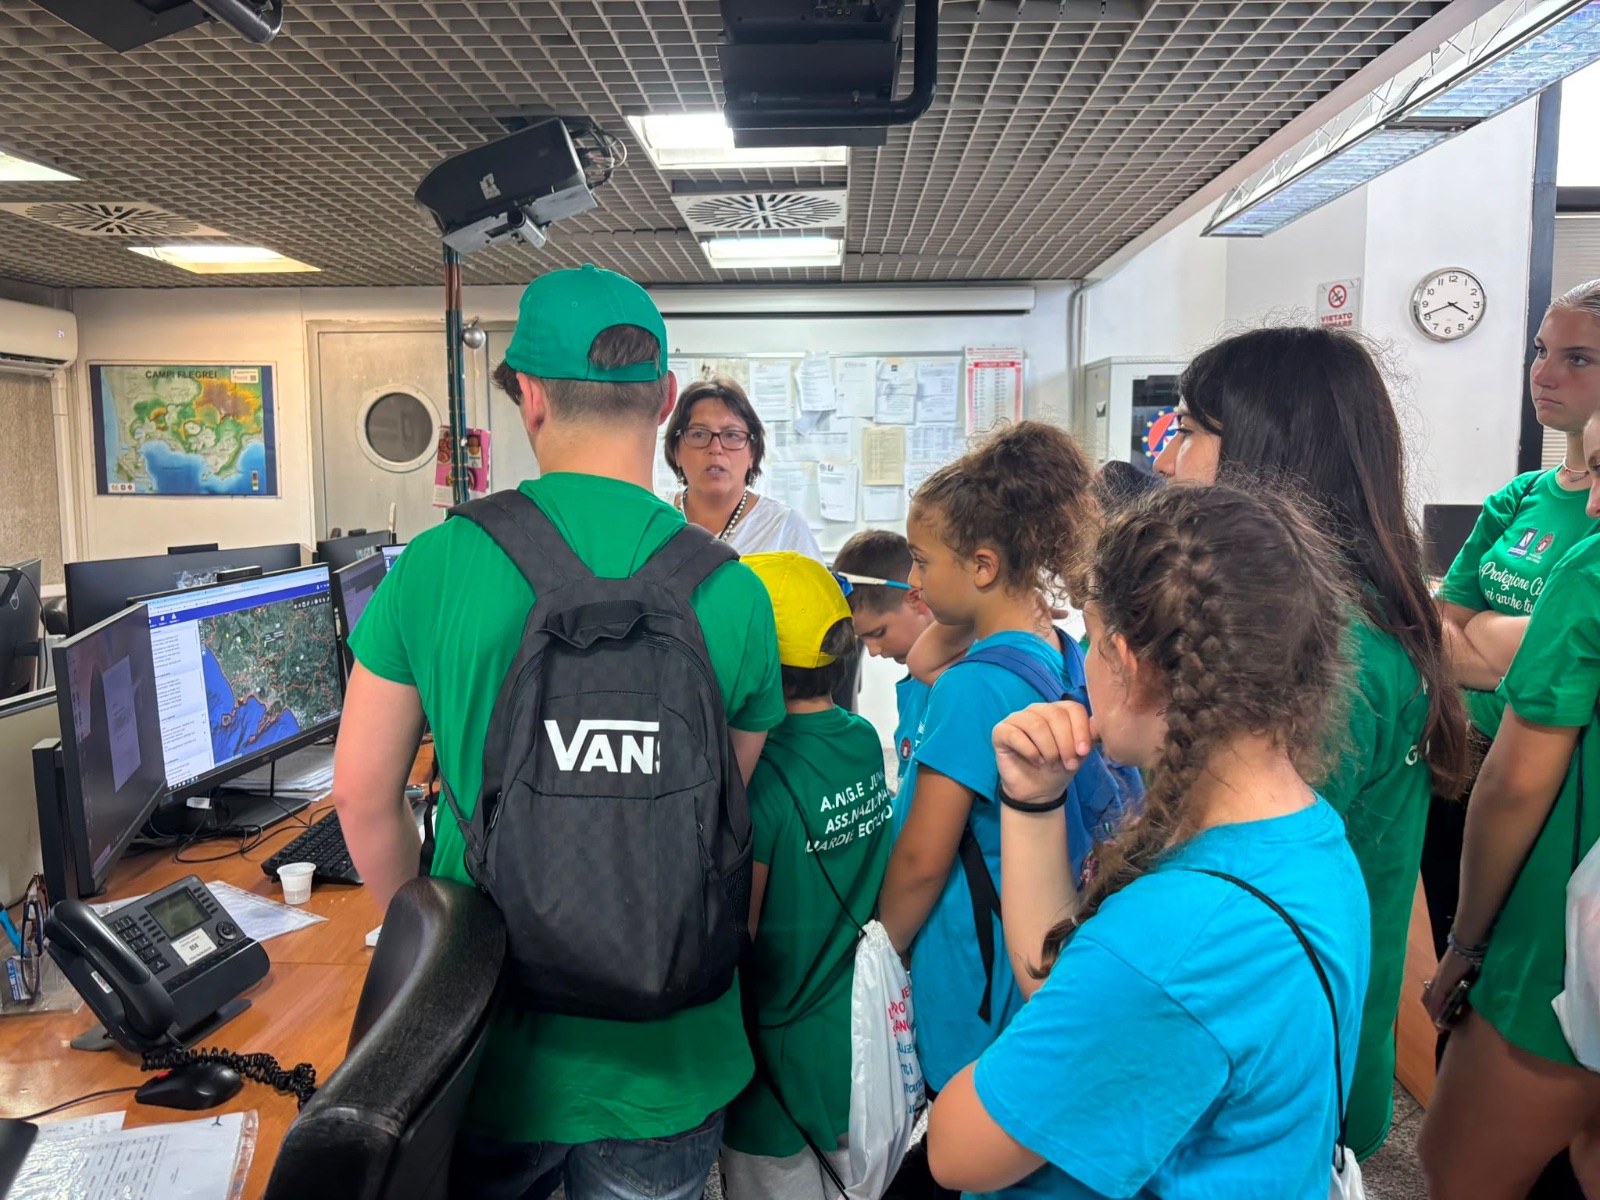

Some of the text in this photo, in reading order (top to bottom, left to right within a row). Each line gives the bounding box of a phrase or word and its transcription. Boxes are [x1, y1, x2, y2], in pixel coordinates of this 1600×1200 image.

[1449, 275, 1458, 283] 12
[1427, 288, 1435, 296] 10
[1470, 288, 1477, 296] 2
[1422, 300, 1429, 308] 9
[1472, 301, 1480, 309] 3
[1321, 312, 1353, 323] VIETATO
[1424, 313, 1431, 321] 8
[1444, 326, 1452, 334] 6
[1457, 323, 1465, 331] 5
[145, 370, 218, 379] CAMPI FLEGREI
[1481, 561, 1530, 591] Protezione
[544, 719, 660, 775] VAN
